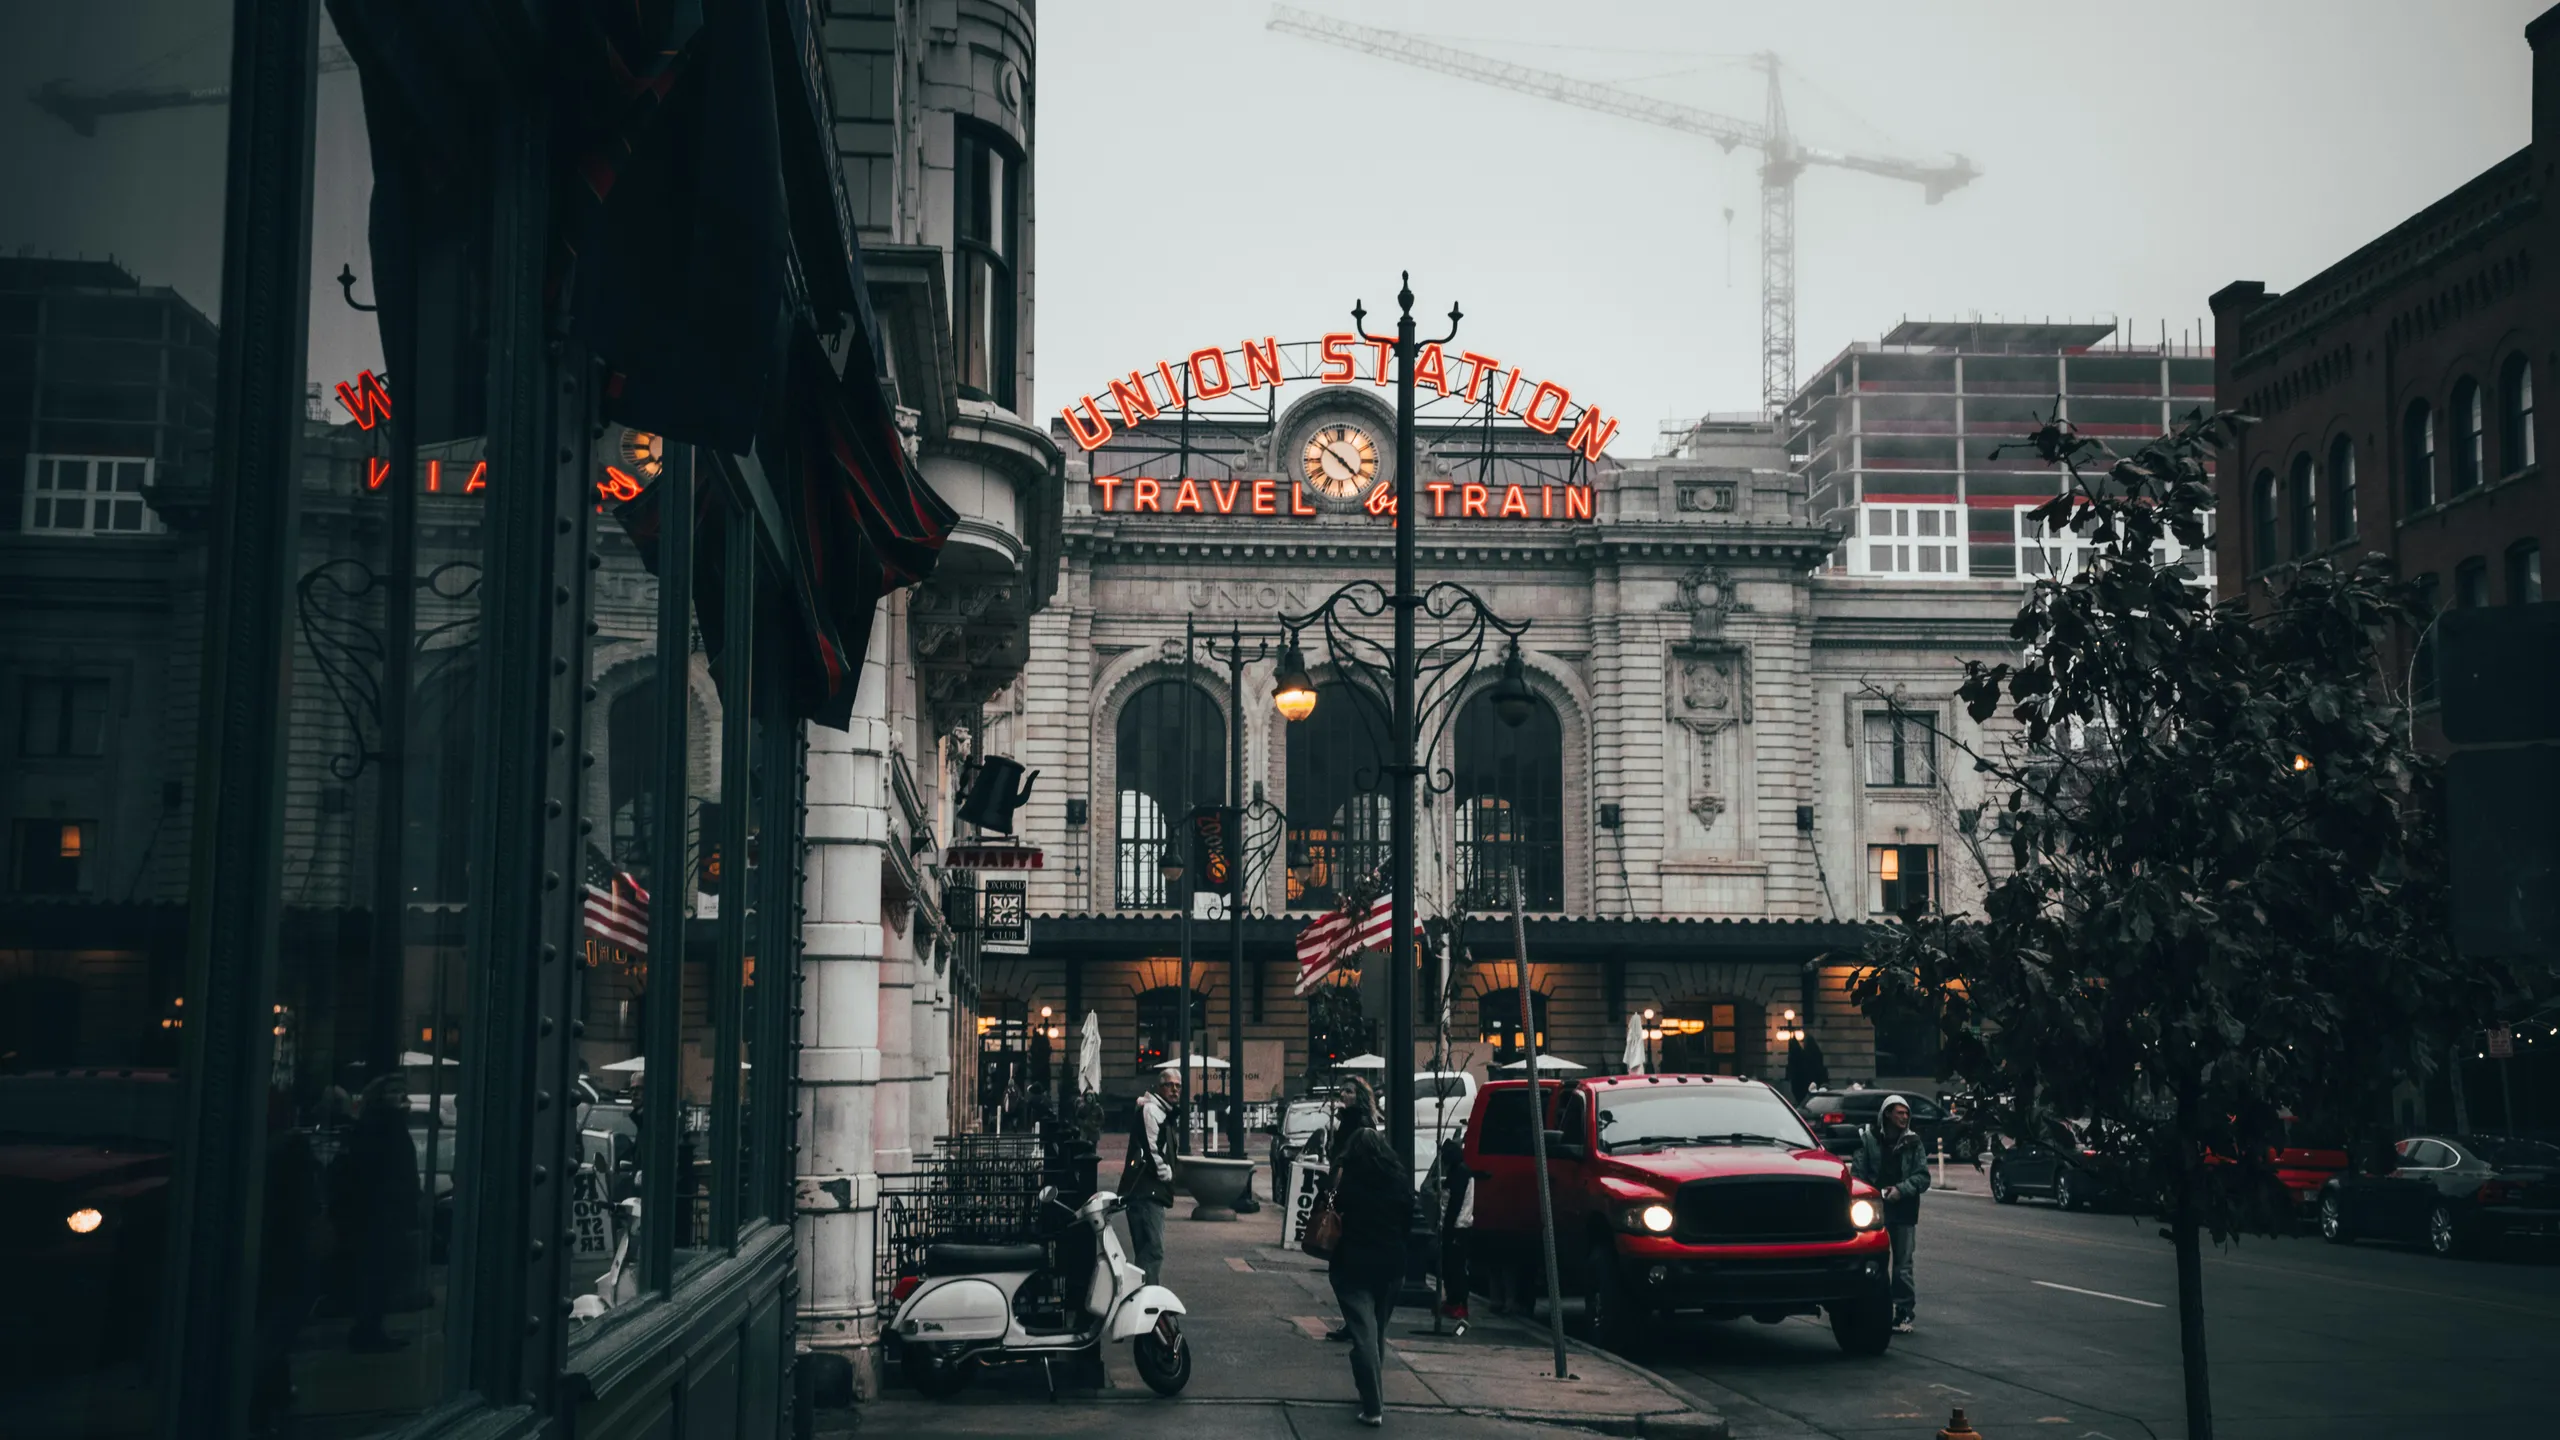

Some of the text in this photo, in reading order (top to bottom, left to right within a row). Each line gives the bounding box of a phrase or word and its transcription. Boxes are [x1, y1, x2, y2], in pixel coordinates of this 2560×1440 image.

[1060, 336, 1284, 451] UNION
[1320, 333, 1619, 462] STATION
[1094, 477, 1317, 516] TRAVEL
[1425, 481, 1593, 519] TRAIN
[1188, 584, 1308, 609] UNION
[986, 881, 1026, 889] OXFORD
[992, 931, 1017, 939] CLUB
